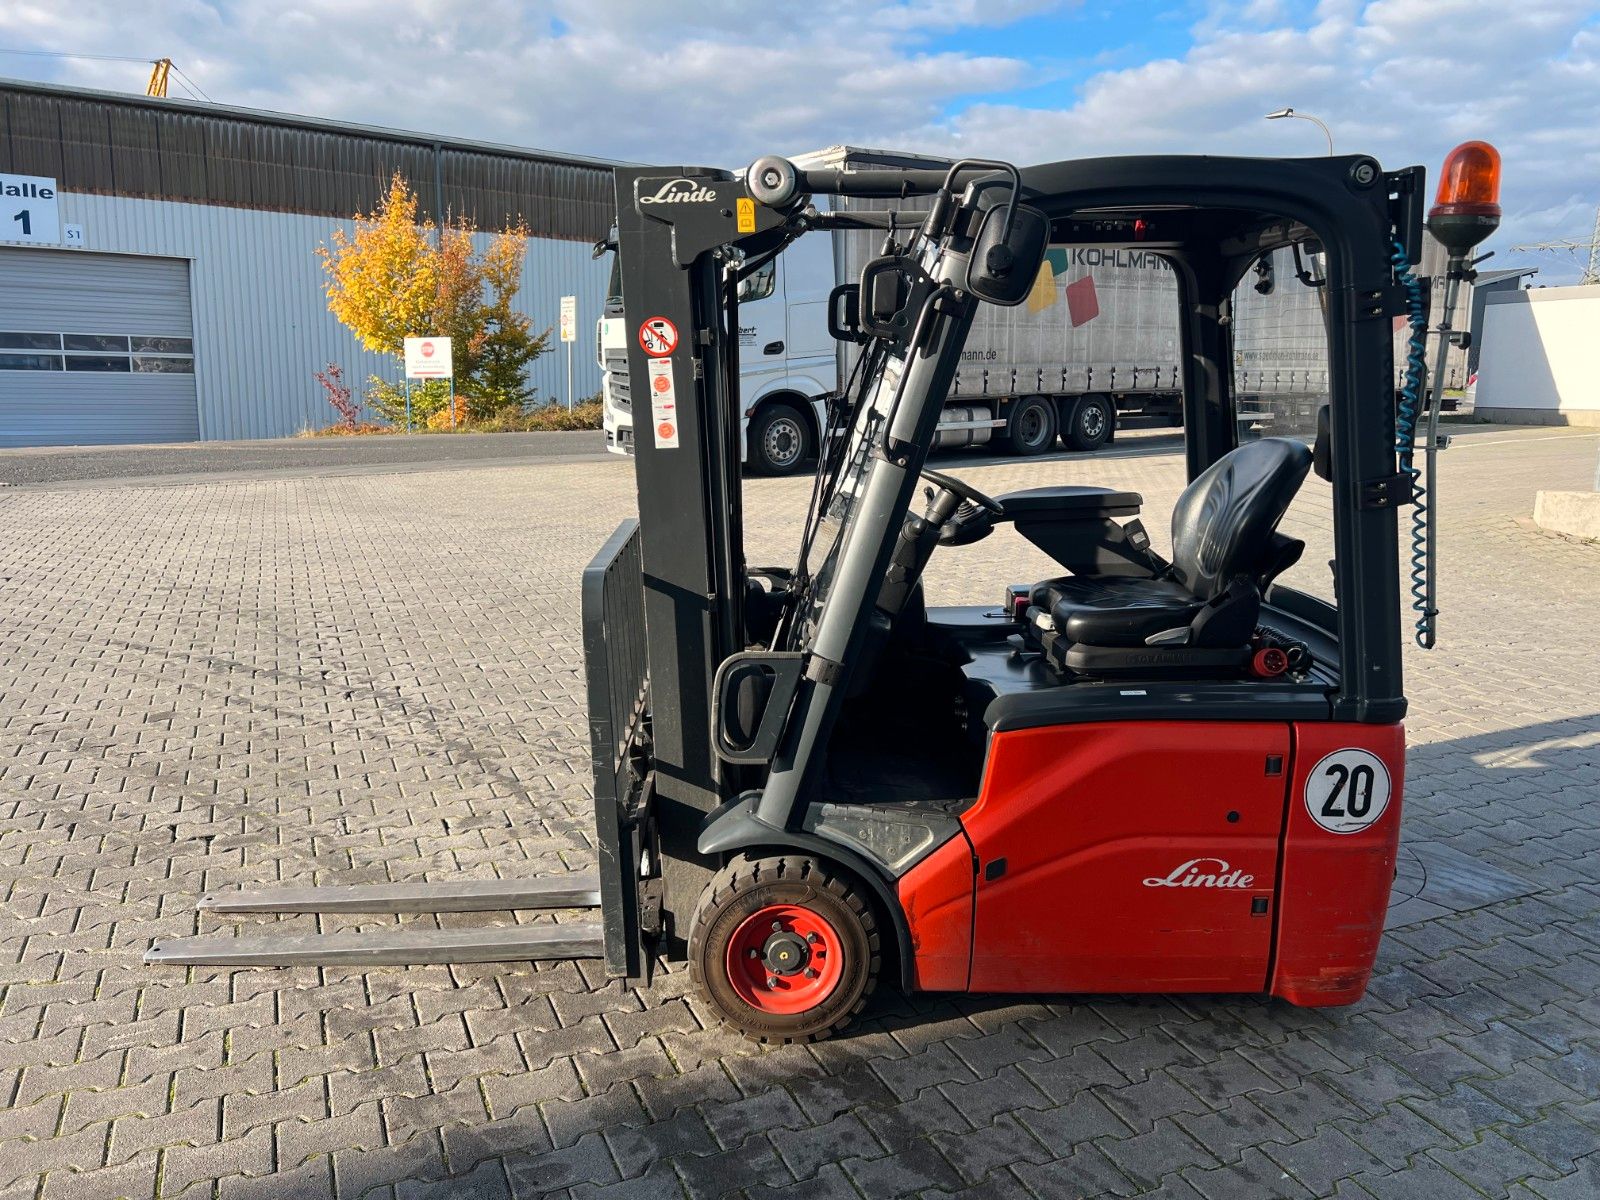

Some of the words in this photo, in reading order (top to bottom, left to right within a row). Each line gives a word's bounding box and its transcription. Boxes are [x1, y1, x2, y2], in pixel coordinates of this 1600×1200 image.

[640, 179, 717, 204] Linde
[14, 209, 31, 235] 1
[1072, 248, 1173, 271] KOHLMAN
[1320, 763, 1375, 818] 20
[1142, 857, 1254, 888] Linde
